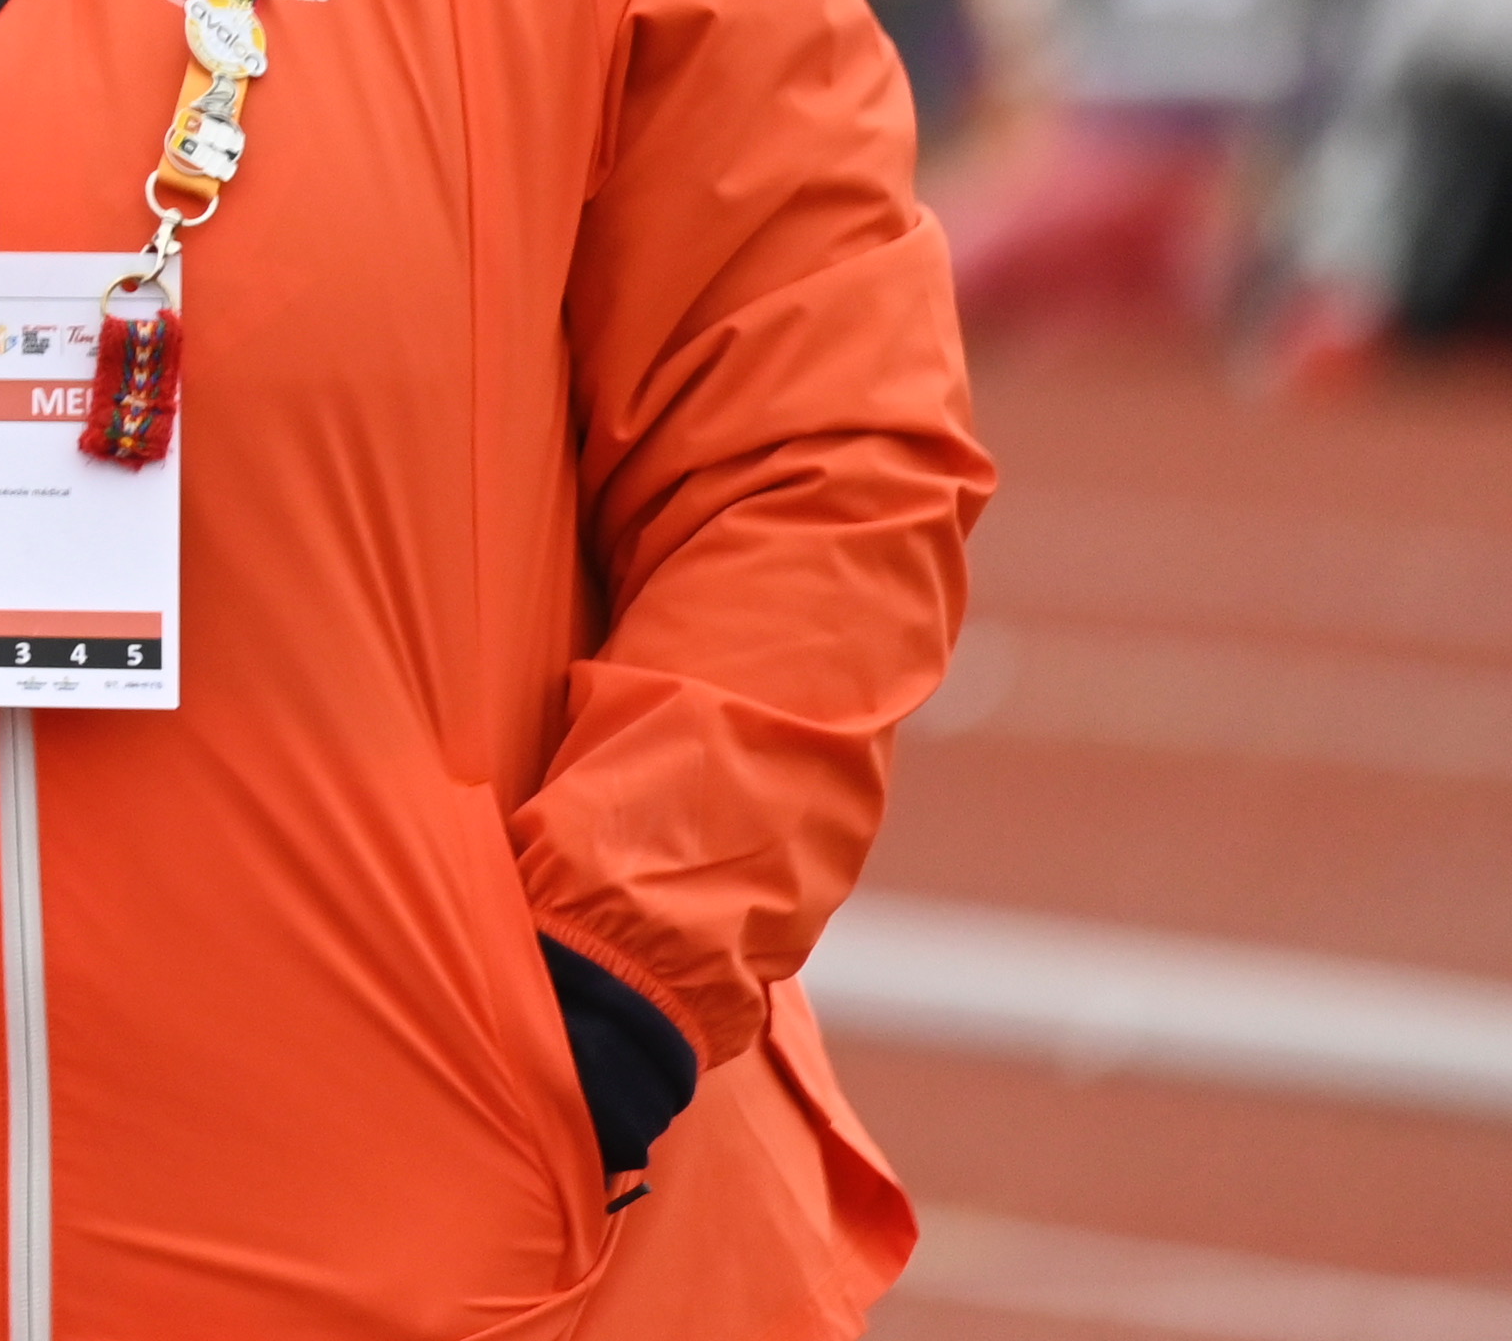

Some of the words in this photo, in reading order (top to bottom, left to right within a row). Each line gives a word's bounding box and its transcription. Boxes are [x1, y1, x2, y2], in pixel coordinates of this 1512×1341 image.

[14, 641, 32, 665] 3
[70, 642, 89, 666] 4
[127, 643, 144, 666] 5
